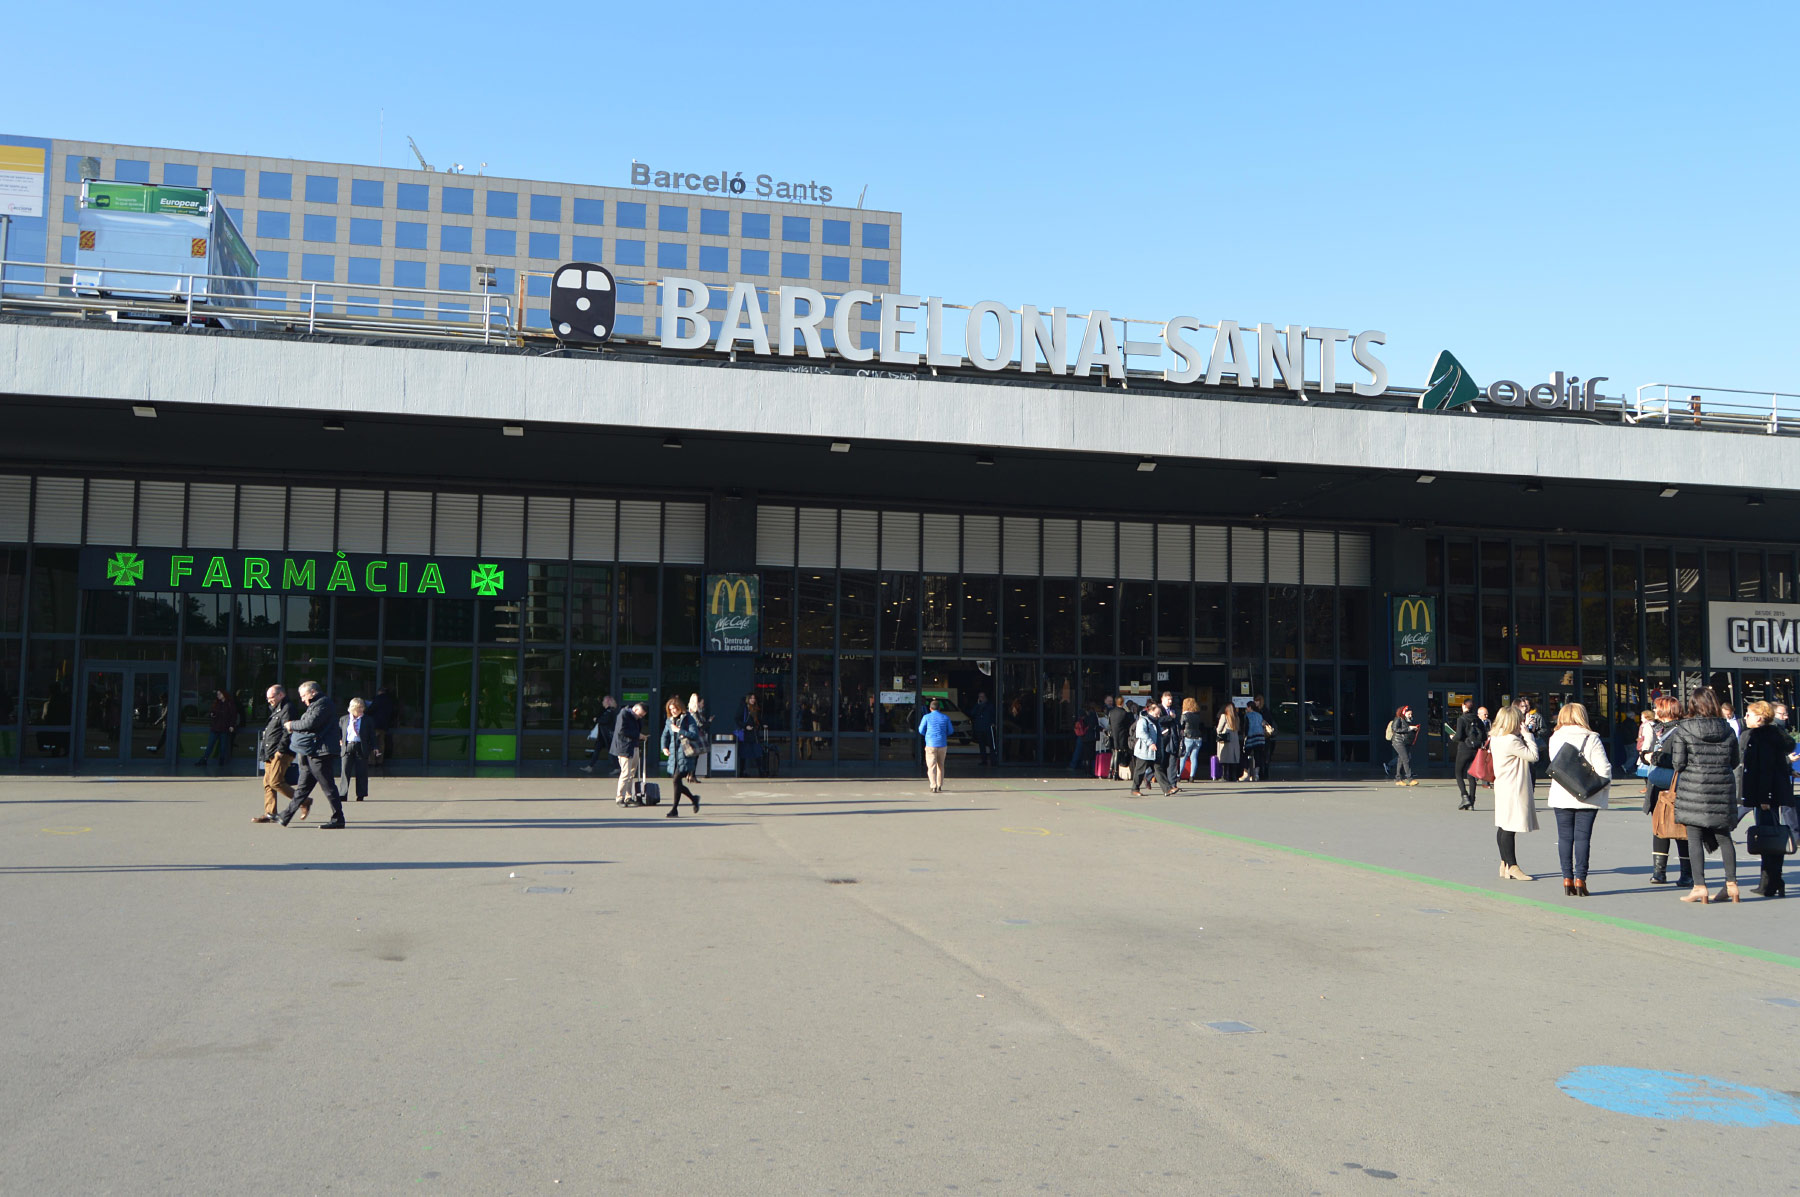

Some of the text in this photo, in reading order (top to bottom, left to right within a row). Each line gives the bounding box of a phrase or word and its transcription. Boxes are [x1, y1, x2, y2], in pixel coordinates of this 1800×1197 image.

[631, 162, 833, 202] Barceló Sants
[160, 198, 200, 208] Europcar
[1487, 371, 1609, 412] adif
[170, 550, 446, 594] FARMÀCIA
[714, 615, 750, 630] McCafé
[1728, 617, 1800, 654] COM
[724, 637, 750, 645] Dentro de
[1537, 649, 1579, 659] TABACS
